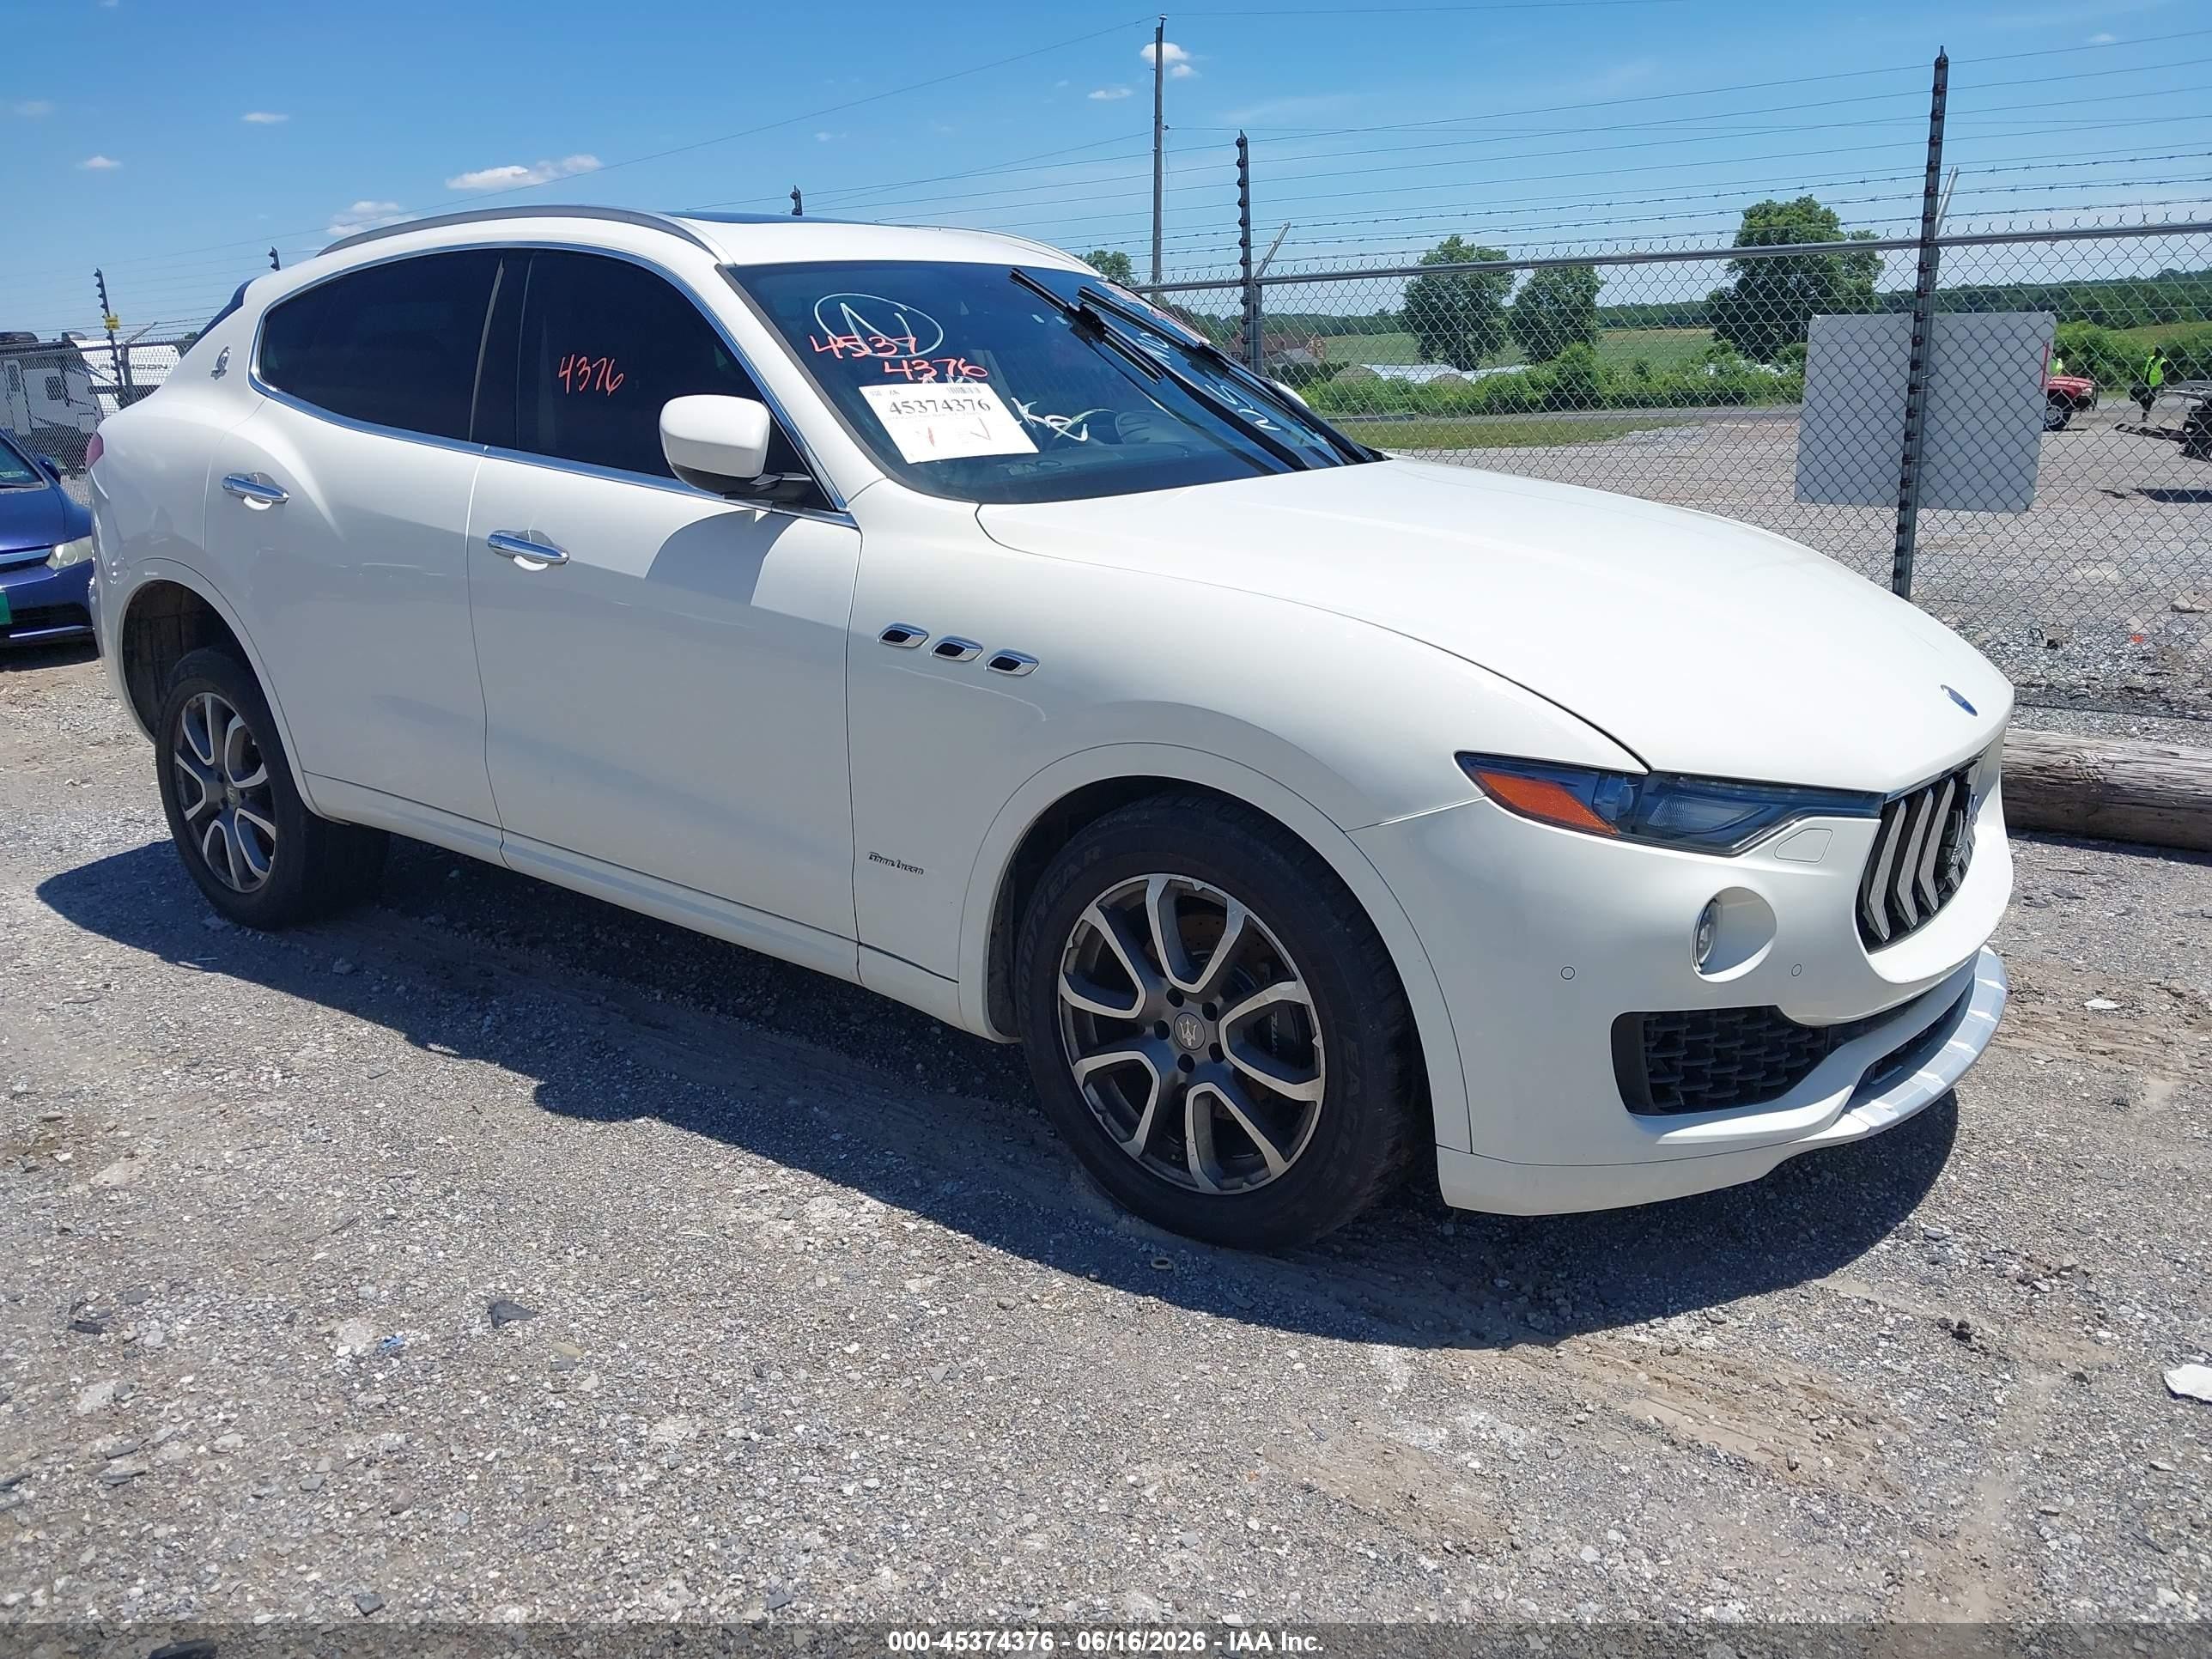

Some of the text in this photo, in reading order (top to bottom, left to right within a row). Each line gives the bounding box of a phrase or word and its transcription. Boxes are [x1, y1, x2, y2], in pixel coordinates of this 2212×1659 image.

[809, 335, 916, 359] 4537
[558, 354, 624, 397] 4376
[884, 357, 988, 380] 4376
[890, 398, 991, 416] 45374376
